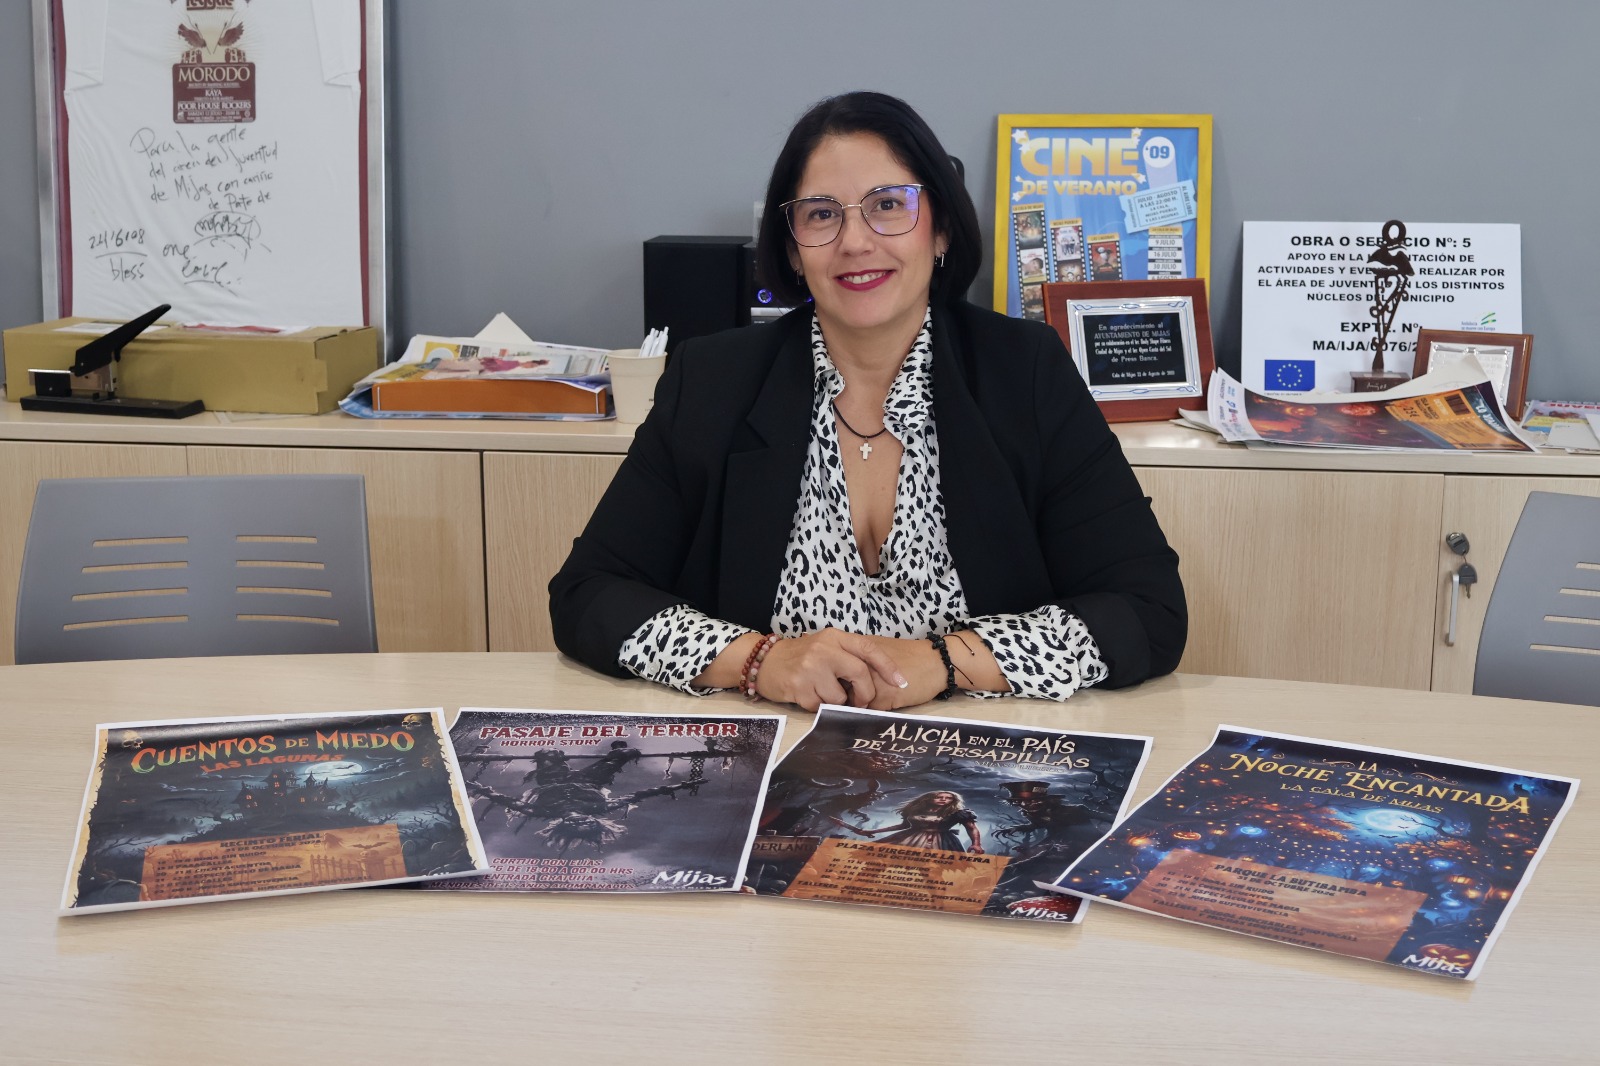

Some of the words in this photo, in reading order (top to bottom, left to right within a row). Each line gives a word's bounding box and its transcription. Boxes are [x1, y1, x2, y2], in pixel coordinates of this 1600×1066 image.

[179, 66, 250, 82] MORODO
[205, 89, 222, 97] KAYA
[198, 101, 220, 110] HOUSE
[222, 100, 251, 109] ROCKERS
[1020, 136, 1139, 176] CINE
[150, 184, 167, 203] de
[217, 179, 239, 192] con
[1023, 180, 1048, 195] DE
[1053, 180, 1137, 196] VERANO
[1137, 195, 1152, 203] JULIO
[1157, 190, 1178, 199] AGOSTO
[1291, 236, 1334, 246] OBRA
[1339, 236, 1350, 246] O
[1355, 236, 1430, 247] SERCIO
[1462, 237, 1471, 248] 5
[1330, 253, 1345, 261] EN
[1349, 253, 1364, 261] LA
[1459, 254, 1475, 262] DE
[1258, 266, 1334, 274] ACTIVIDADES
[1338, 266, 1346, 274] Y
[1419, 268, 1477, 276] REALIZAR
[1481, 268, 1505, 276] POR
[1258, 279, 1272, 287] EL
[1275, 278, 1306, 287] ÁREA
[1329, 280, 1393, 288] JUVENT
[1415, 281, 1438, 289] LOS
[1307, 292, 1362, 301] NÚCLEOS
[1366, 294, 1387, 302] DL
[1393, 294, 1455, 302] UNICIPIO
[1110, 322, 1155, 331] agradecimiento
[1341, 322, 1396, 333] EXPT.
[1094, 331, 1140, 339] AYUNTAMIENTO
[479, 725, 574, 739] PASAJE
[580, 725, 630, 738] DEL
[636, 723, 739, 737] TERROR
[500, 739, 556, 747] HORROR
[560, 738, 602, 746] STORY
[878, 722, 961, 747] ALICIA
[967, 735, 990, 747] EN
[992, 736, 1015, 749] EL
[1020, 734, 1076, 754] PAÍS
[131, 735, 277, 773] CUENTOS
[285, 738, 309, 749] DE
[316, 730, 415, 751] MIEDO
[852, 738, 886, 751] DE
[889, 742, 929, 755] LAS
[936, 745, 1090, 770] PESADILLAS
[200, 760, 242, 773] LAS
[245, 753, 346, 767] LAGUNAS
[1358, 761, 1378, 773] LA
[1220, 753, 1334, 781] NOCHE
[1341, 771, 1530, 814] ENCANTADA
[1280, 783, 1304, 792] LA
[1309, 786, 1356, 798] CALA
[1361, 793, 1386, 803] DE
[1388, 798, 1444, 813] MIJAS
[220, 838, 276, 847] RECINTO
[280, 833, 320, 842] FERIAL
[252, 842, 297, 851] OCTUBRE
[753, 842, 816, 852] DERLAND
[836, 842, 874, 851] PLAZA
[878, 846, 922, 856] VIRGEN
[570, 857, 603, 866] ELÍAS
[890, 854, 932, 863] OCTUBRE
[560, 866, 568, 874] A
[609, 867, 634, 875] HRS
[861, 866, 929, 877] CUENTACUENTOS
[539, 874, 593, 882] GRATUITA
[651, 870, 727, 886] Mijas
[1215, 864, 1268, 879] PARQUE
[1269, 873, 1286, 881] LA
[1289, 877, 1367, 896] BUTIBAMBA
[1246, 886, 1274, 894] RUIDO
[1264, 880, 1310, 892] OCTUBRE
[1188, 895, 1217, 903] JUEGO
[1219, 900, 1289, 917] SUPERVIVENCIA
[1271, 903, 1300, 912] MAGIA
[1011, 906, 1068, 919] Mijas
[1402, 954, 1465, 974] Mijas
